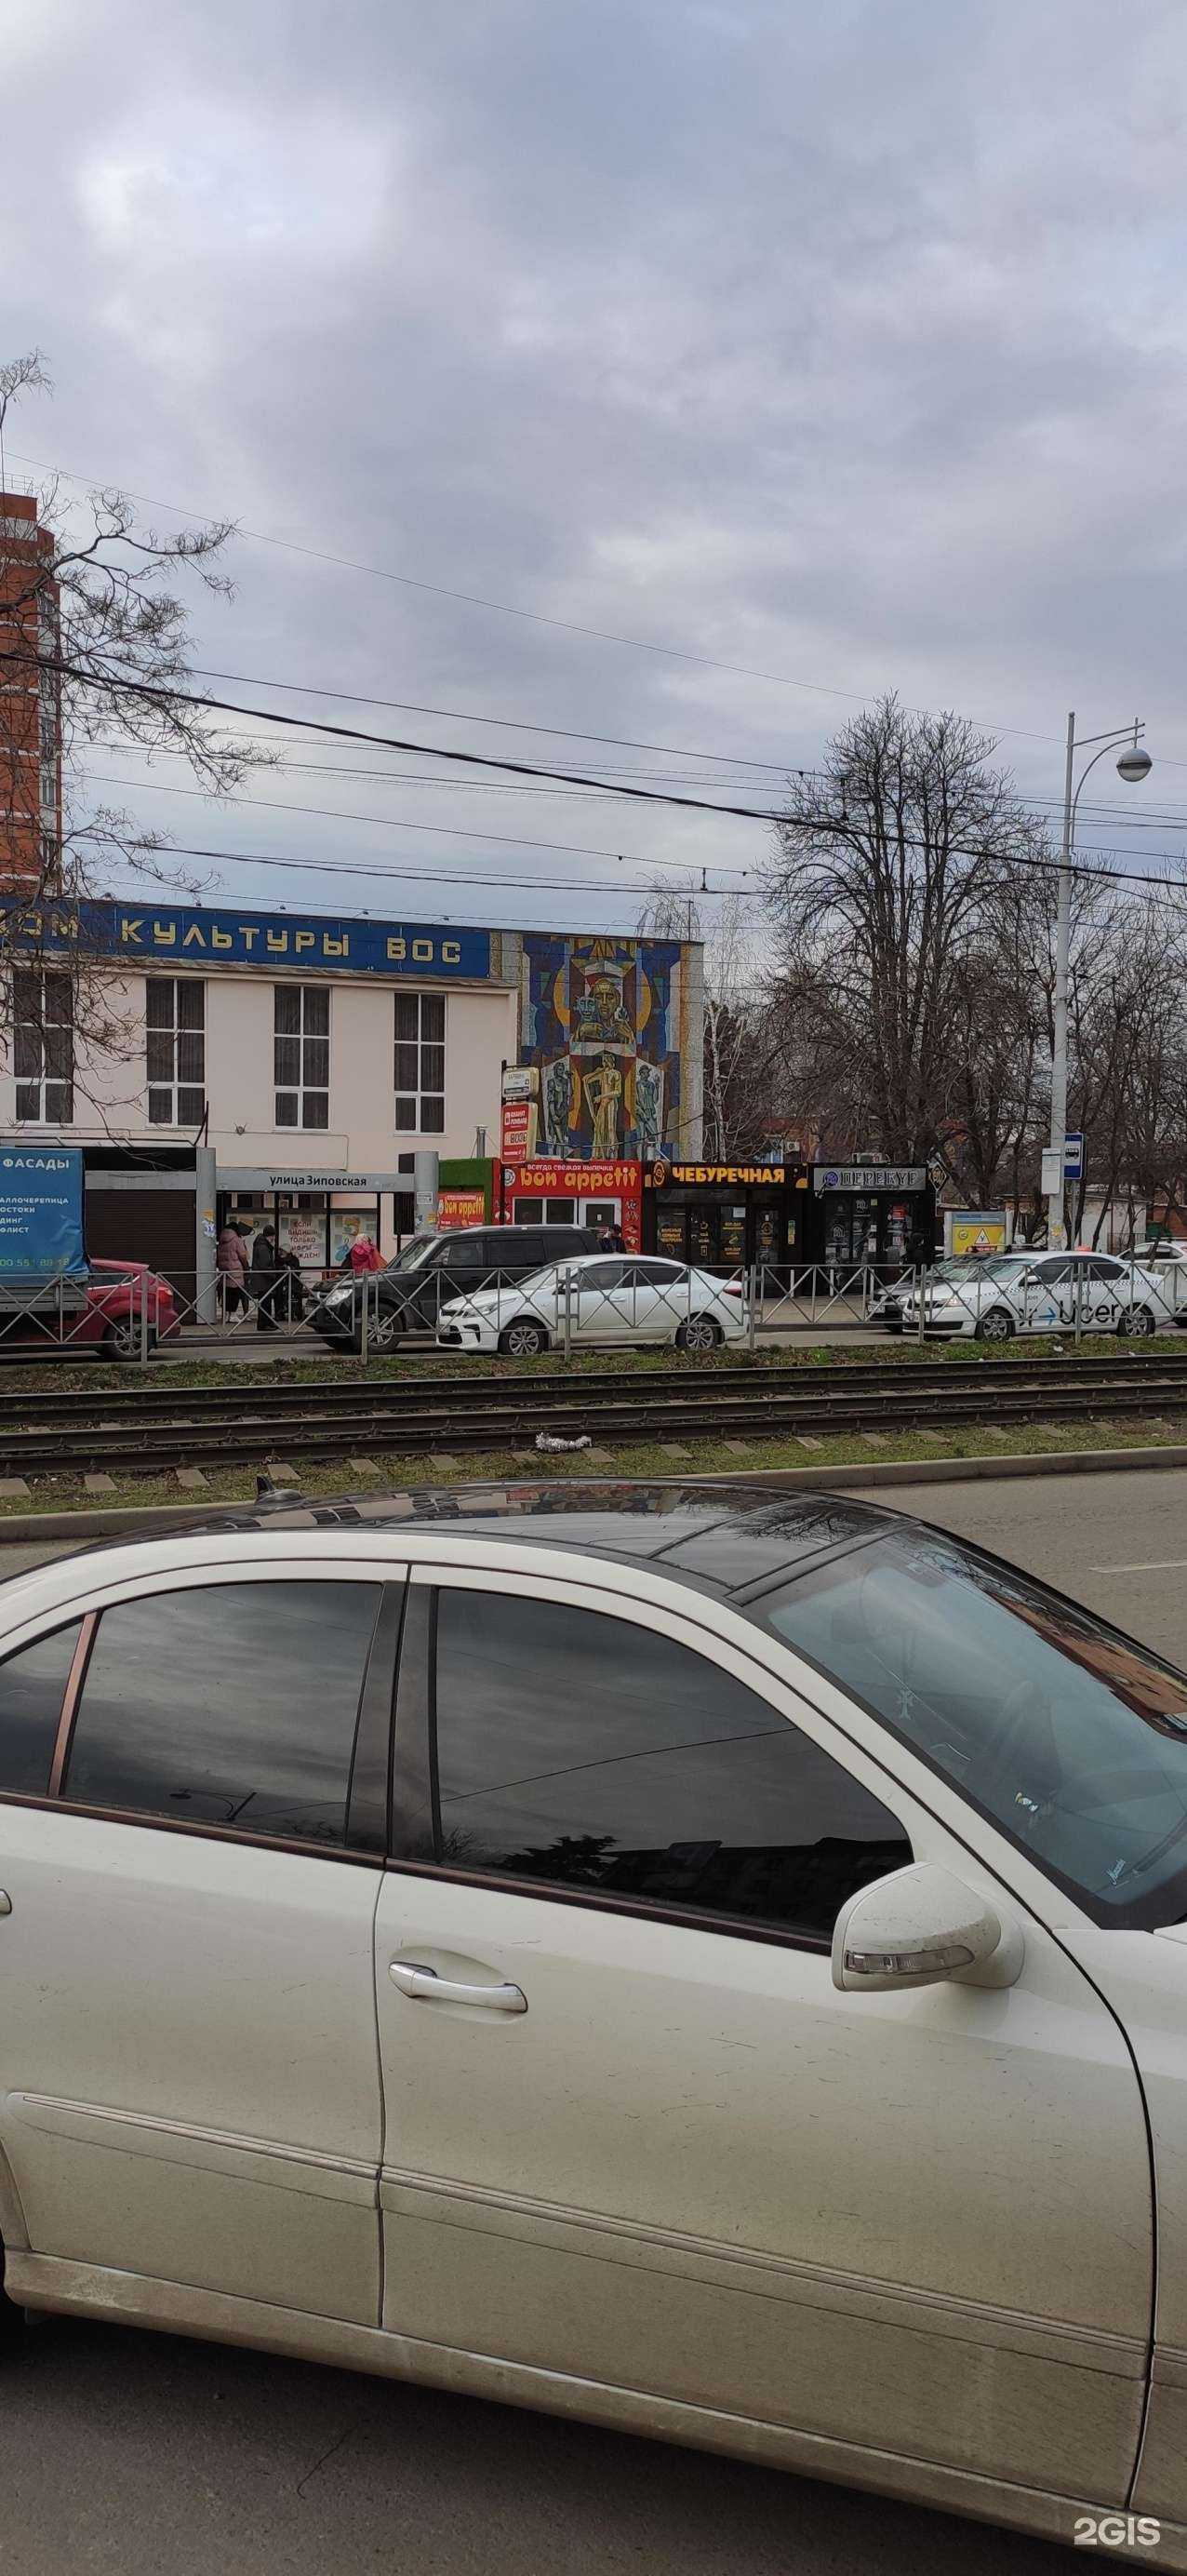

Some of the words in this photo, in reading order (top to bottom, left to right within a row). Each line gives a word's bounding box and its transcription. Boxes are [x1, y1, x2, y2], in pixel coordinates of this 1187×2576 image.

[0, 908, 78, 938] ОМ
[121, 919, 350, 957] КУЛЬТУРЫ
[387, 937, 461, 963] ВОС
[3, 1158, 70, 1171] ФАСАДЫ
[270, 1176, 305, 1187] улица
[306, 1175, 367, 1187] Зиповская
[520, 1167, 557, 1187] bon
[564, 1167, 637, 1191] appetit
[672, 1167, 785, 1184] ЧЕБУРЕЧНАЯ
